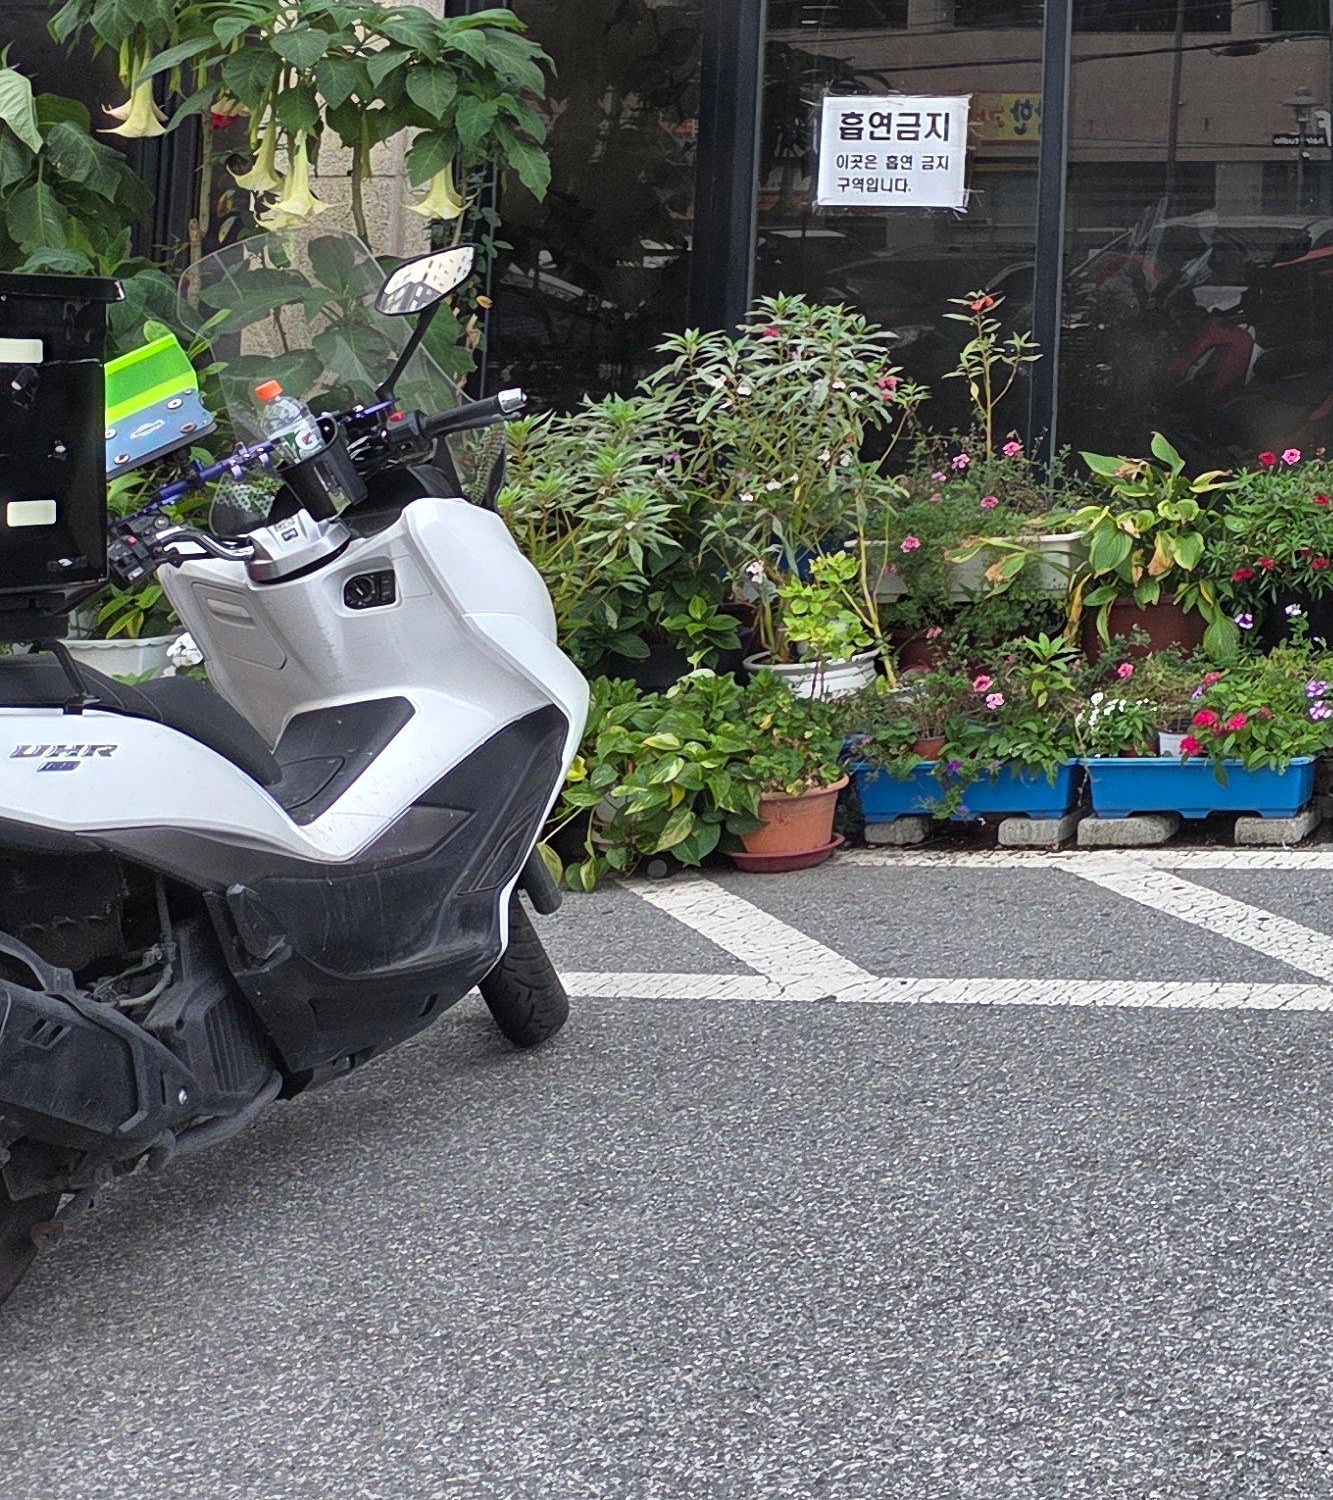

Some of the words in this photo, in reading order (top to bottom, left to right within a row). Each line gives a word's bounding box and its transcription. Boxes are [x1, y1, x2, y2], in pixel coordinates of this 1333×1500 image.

[838, 111, 950, 142] 흡연금지
[836, 153, 878, 171] 이곳은
[885, 154, 914, 171] 흡연
[921, 155, 950, 171] 금지
[837, 177, 912, 193] 구역입니다.
